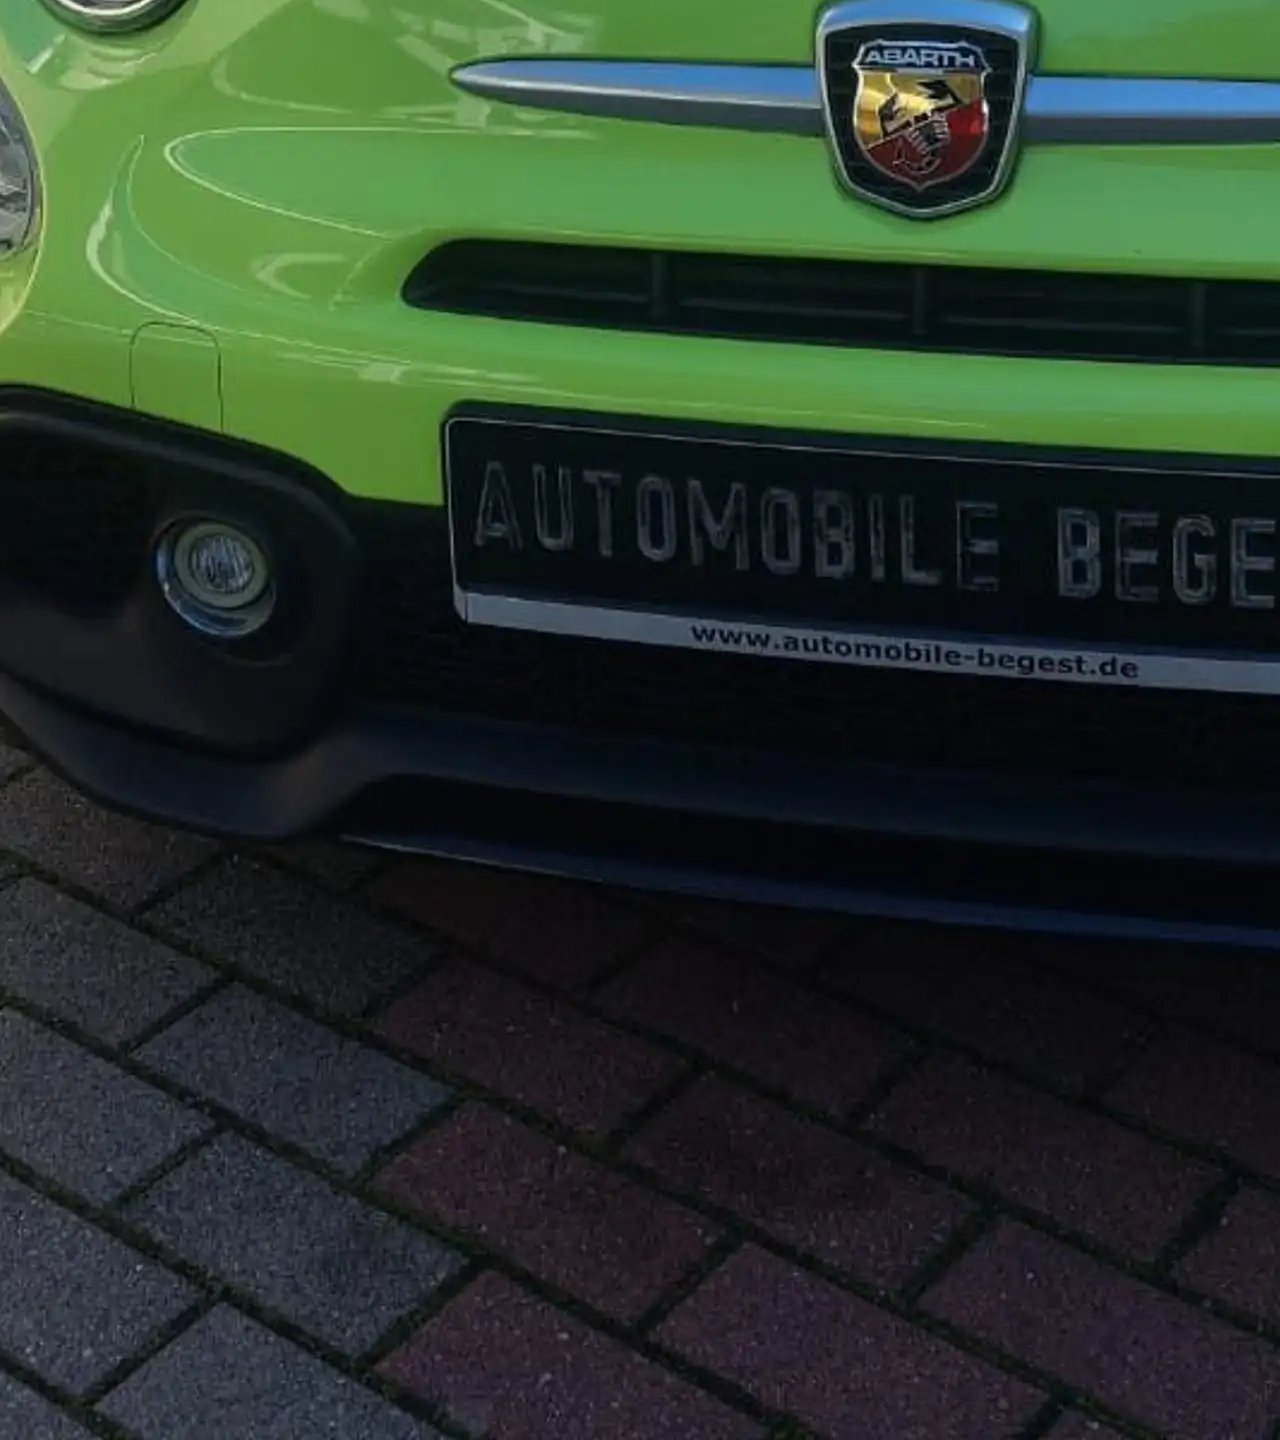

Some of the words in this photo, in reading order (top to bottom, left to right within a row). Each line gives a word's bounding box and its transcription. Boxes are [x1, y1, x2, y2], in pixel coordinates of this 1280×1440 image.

[865, 48, 976, 67] ABARTH
[473, 459, 1001, 593] AUTOMOBILE
[690, 623, 1140, 679] www.automobile-begest.de
